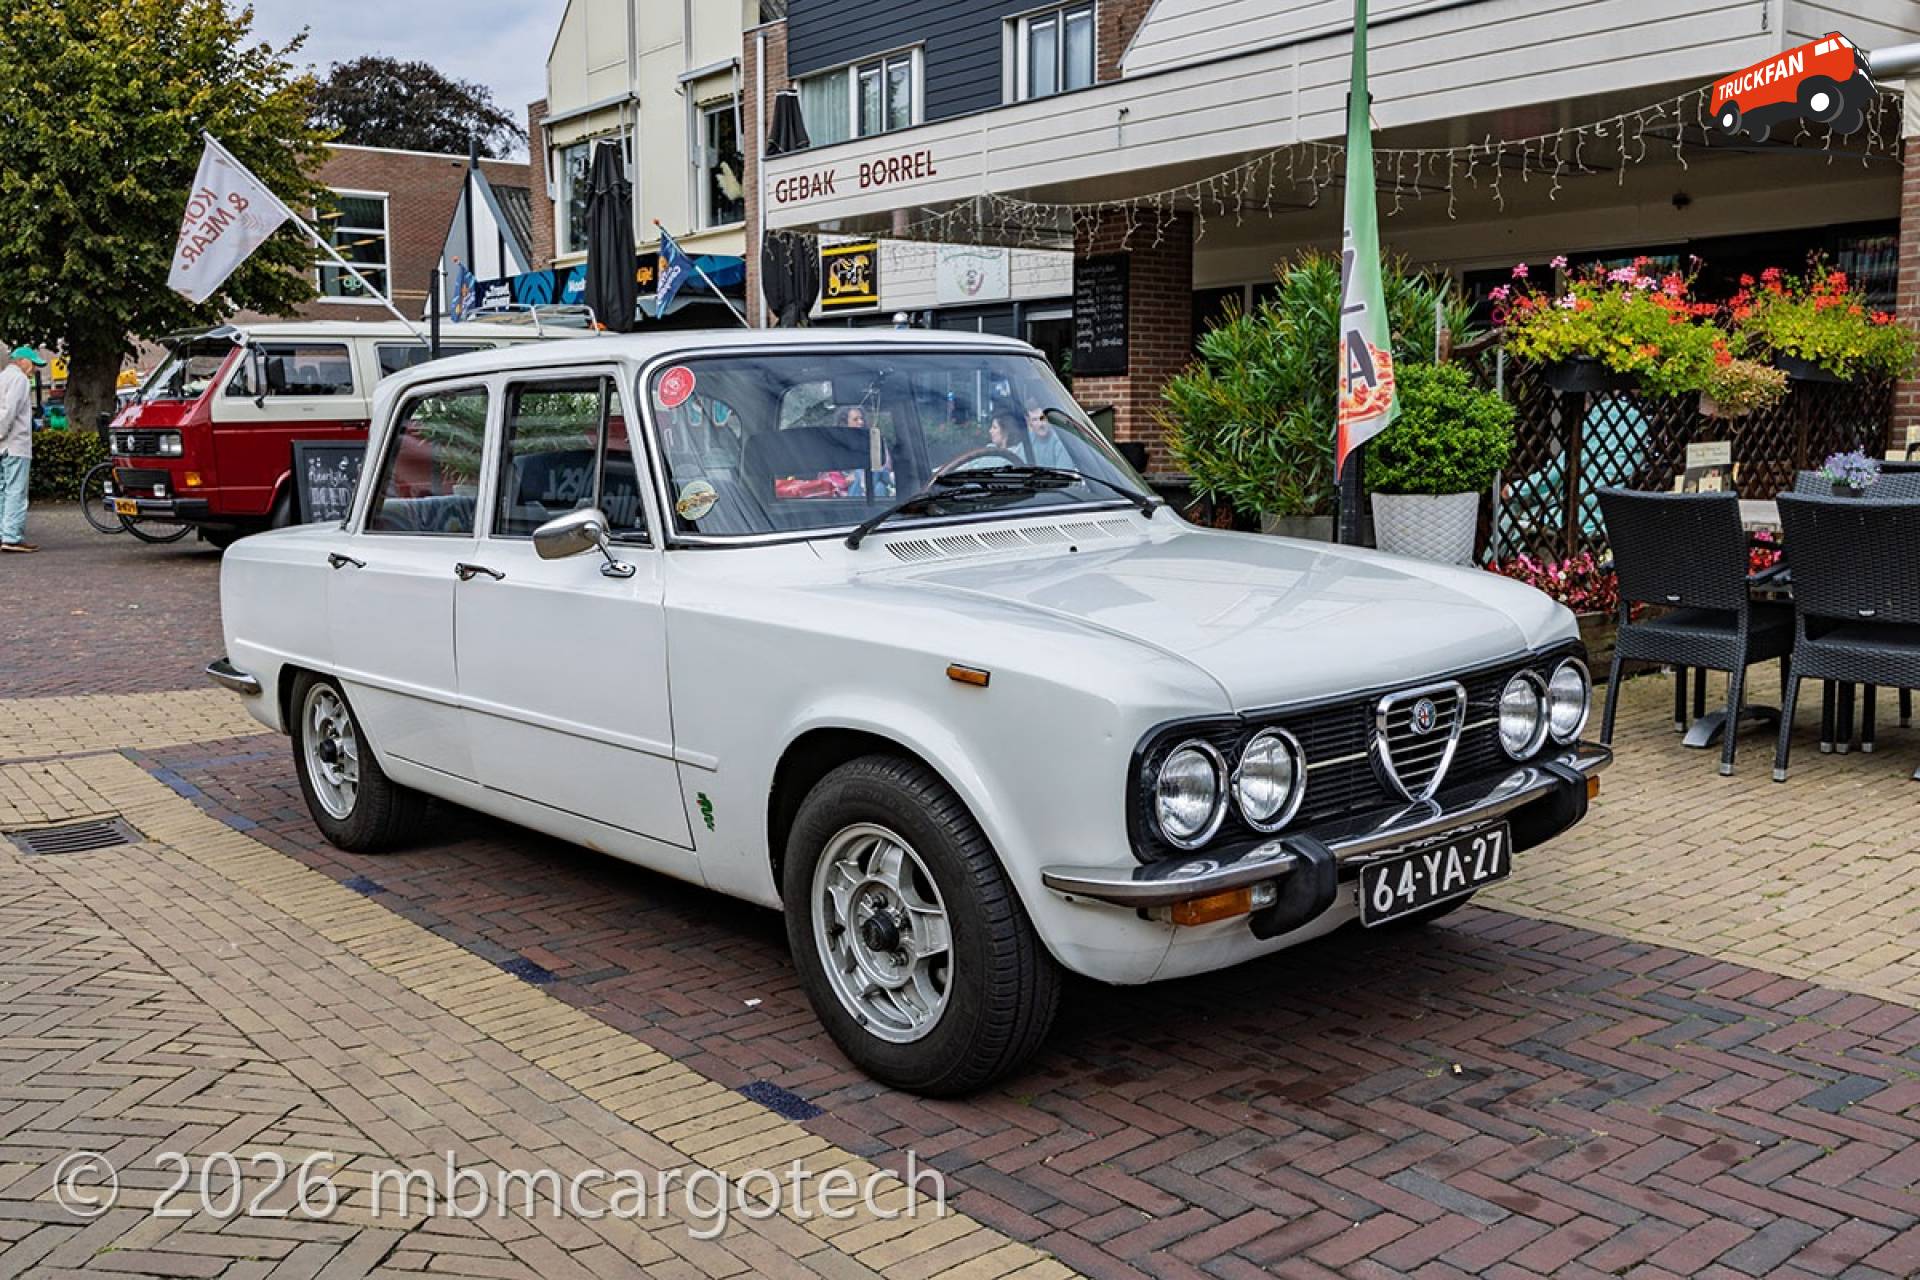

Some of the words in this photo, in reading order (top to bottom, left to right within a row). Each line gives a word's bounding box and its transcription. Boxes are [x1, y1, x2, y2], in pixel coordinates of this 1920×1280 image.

[775, 169, 836, 204] GEBAK
[859, 150, 937, 189] BORREL
[1373, 831, 1503, 913] 64-YA-27
